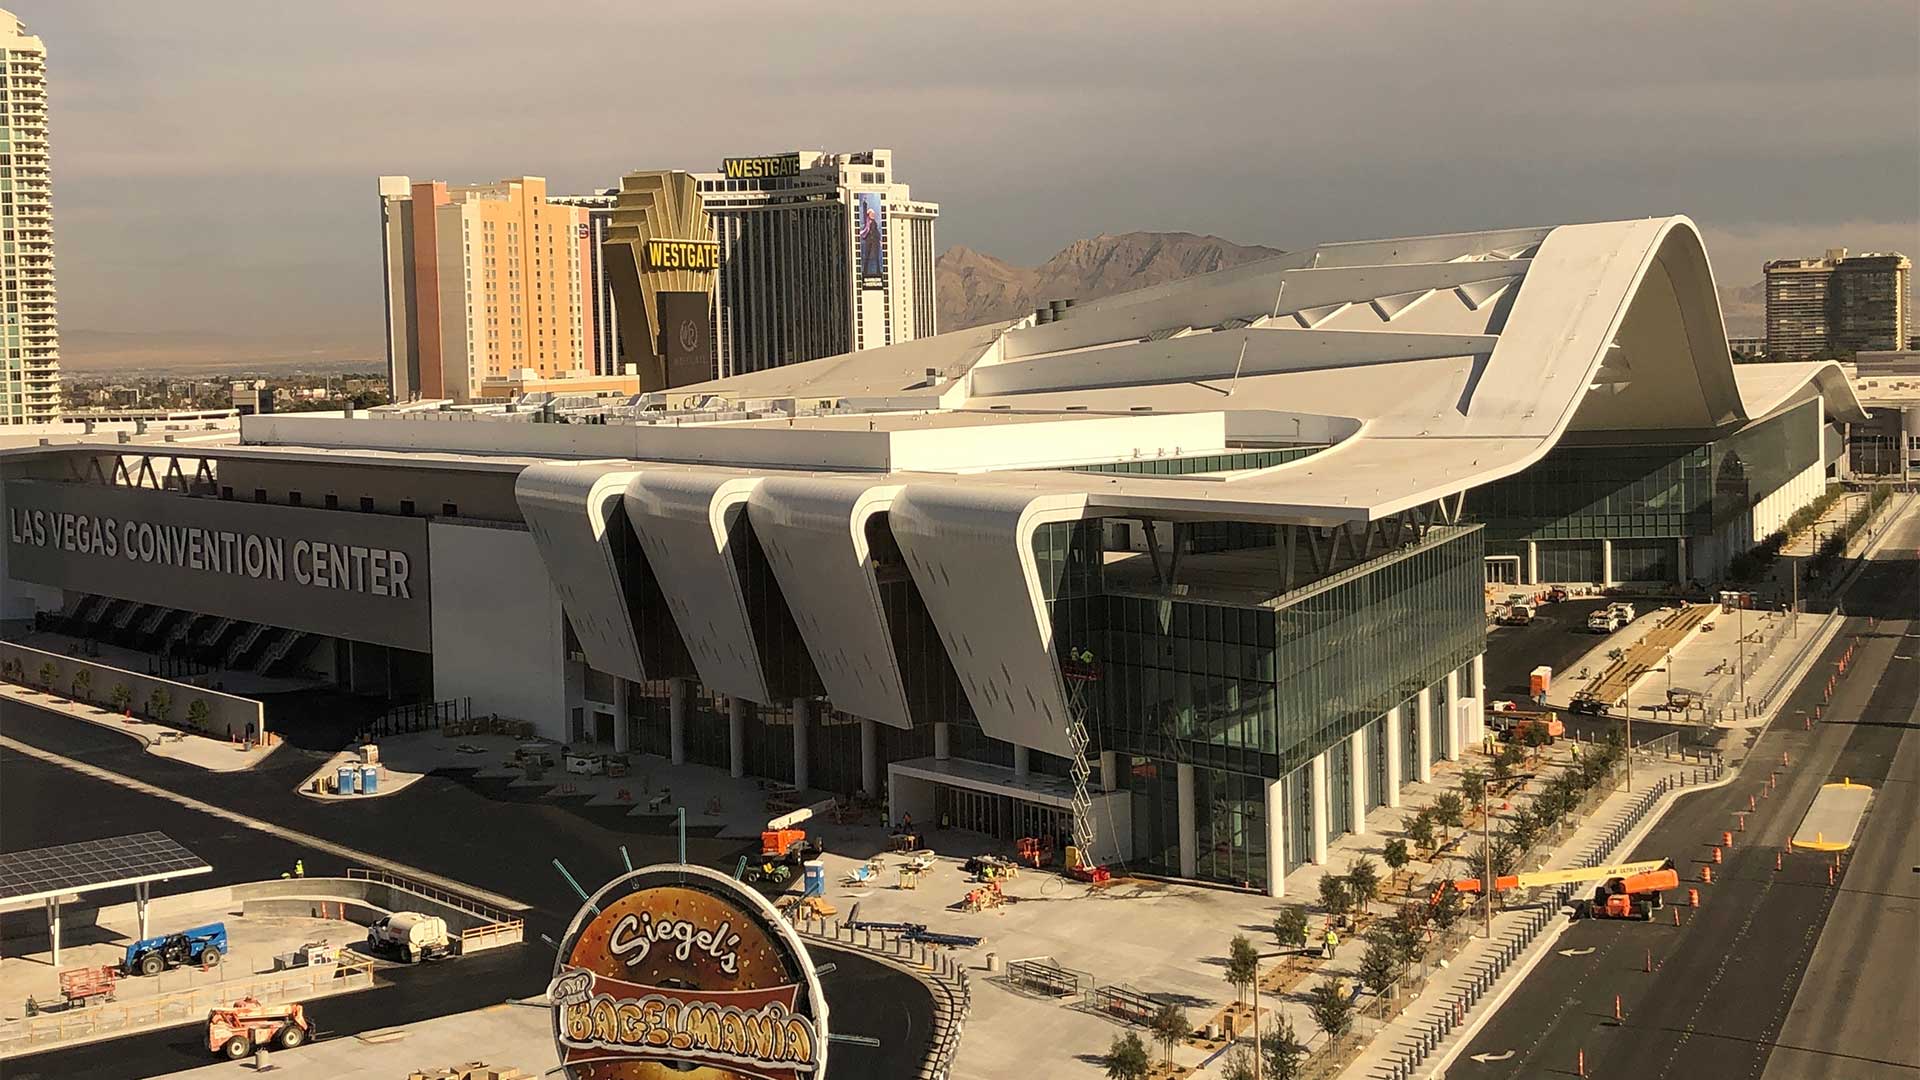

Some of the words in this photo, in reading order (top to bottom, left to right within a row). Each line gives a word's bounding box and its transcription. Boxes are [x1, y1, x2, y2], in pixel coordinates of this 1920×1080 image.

[725, 158, 799, 178] WESTGATE
[649, 243, 719, 267] WESTGATE
[11, 507, 46, 547] LAS
[51, 512, 118, 557] VEGAS
[123, 521, 285, 581] CONVENTION
[293, 540, 411, 599] CENTER
[611, 913, 740, 974] Siegel's
[566, 999, 813, 1063] BAGELMANIA
